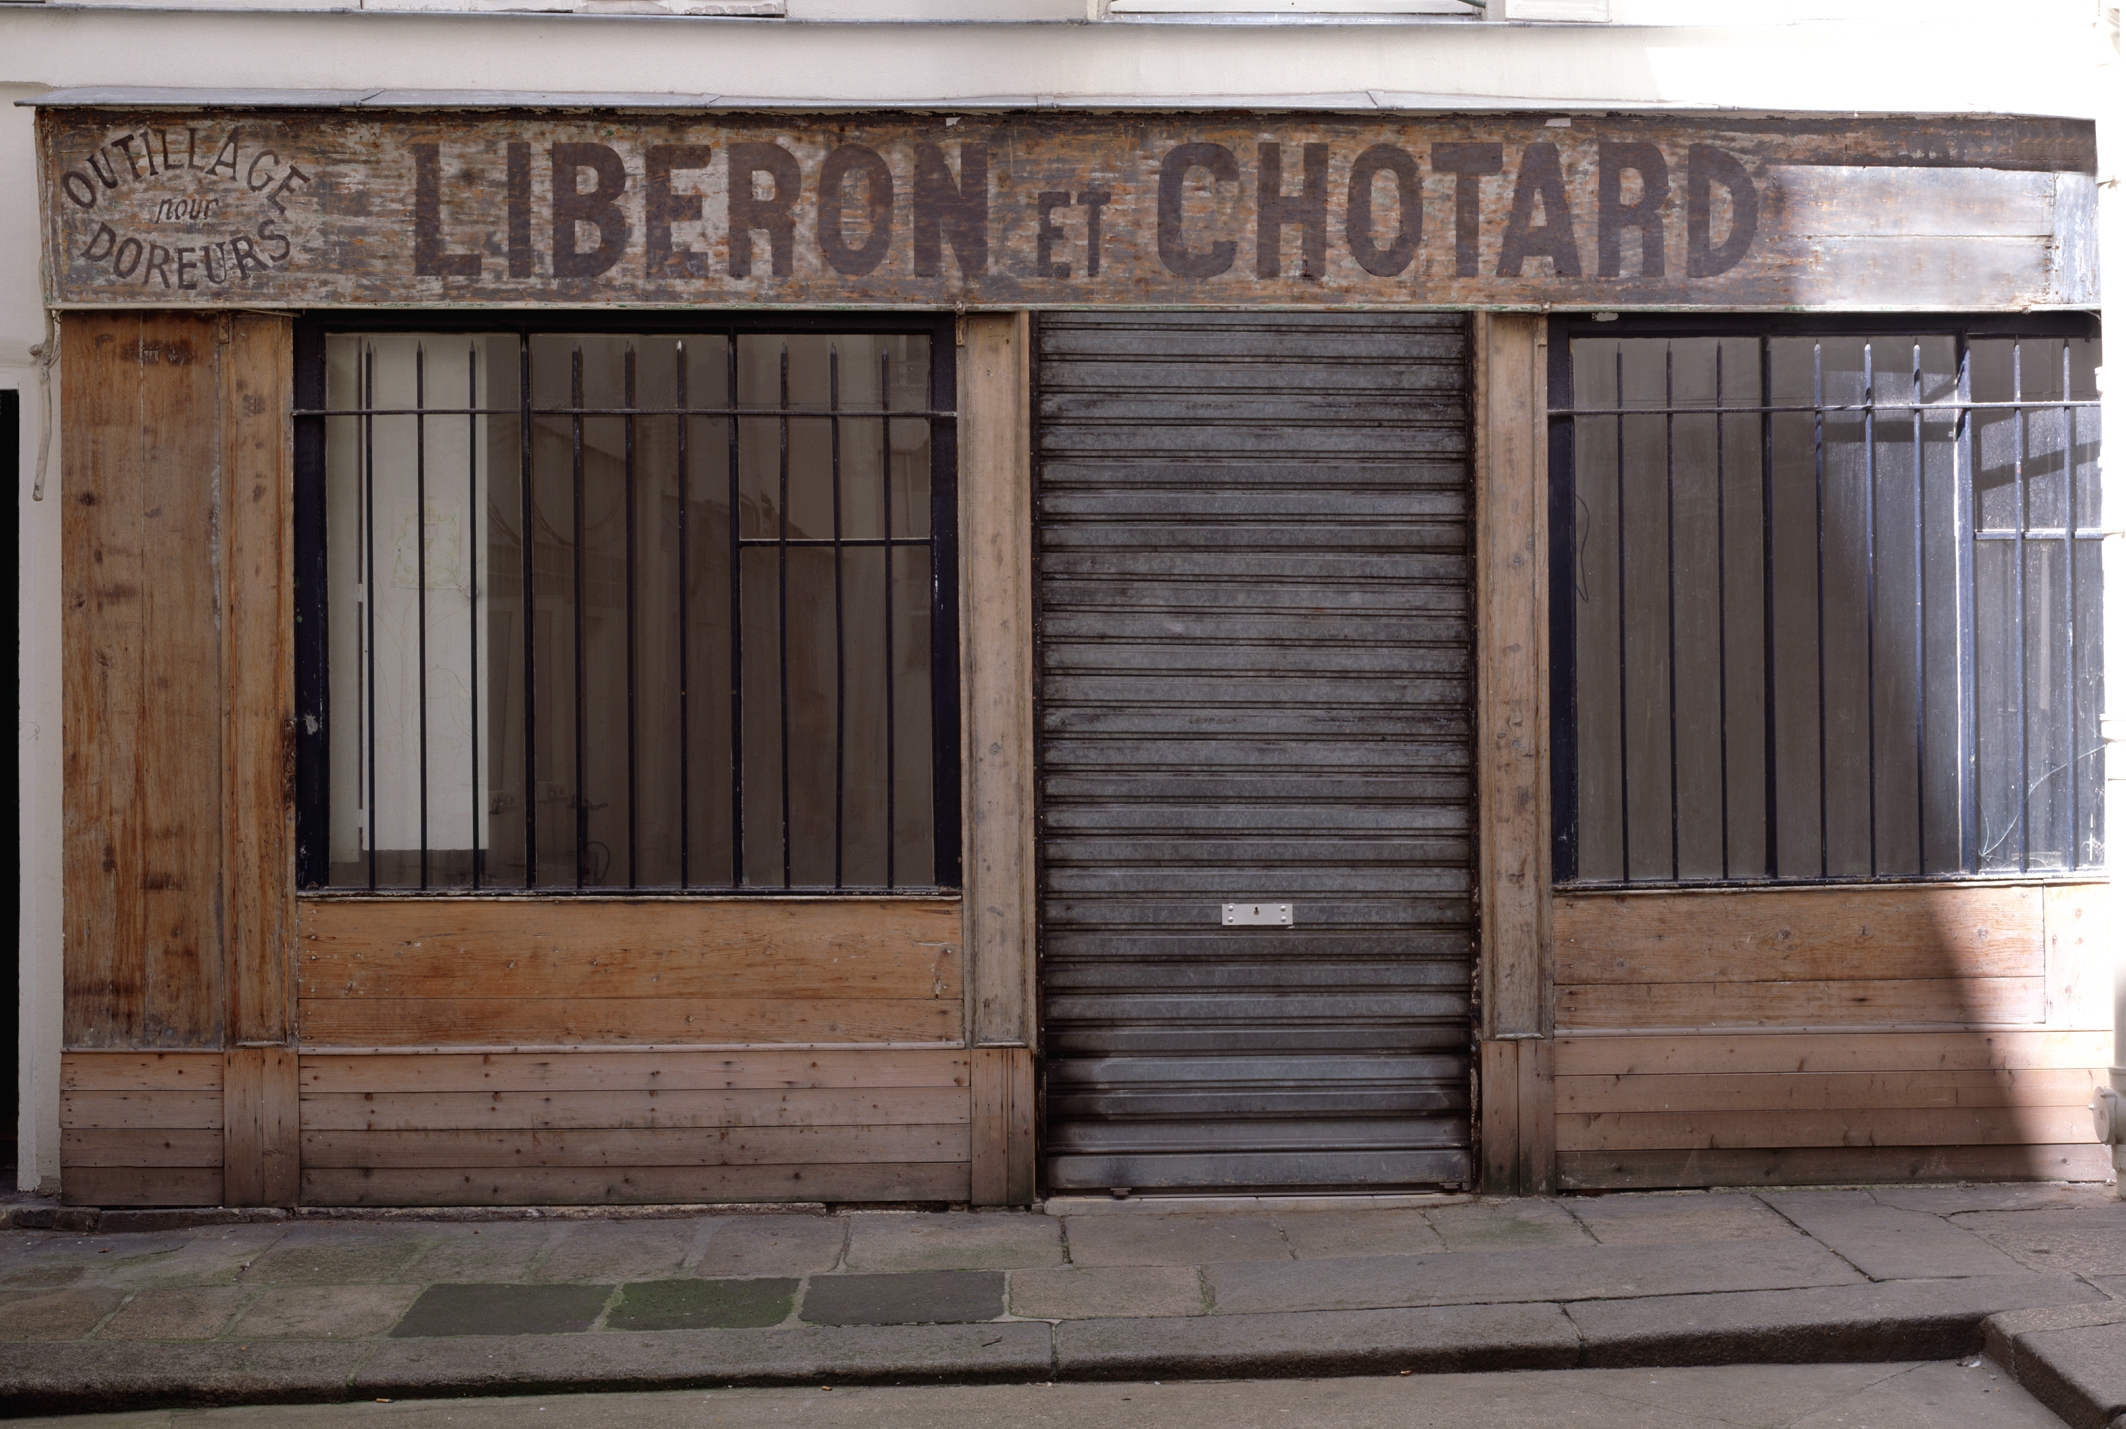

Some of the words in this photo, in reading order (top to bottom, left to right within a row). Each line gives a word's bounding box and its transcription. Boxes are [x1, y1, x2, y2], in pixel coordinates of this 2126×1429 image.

[62, 126, 311, 214] OUTILLAGE
[415, 141, 988, 280] LIBERON
[1037, 191, 1111, 278] ET
[1157, 141, 1759, 279] CHOTARD
[81, 219, 291, 290] DOREURS
